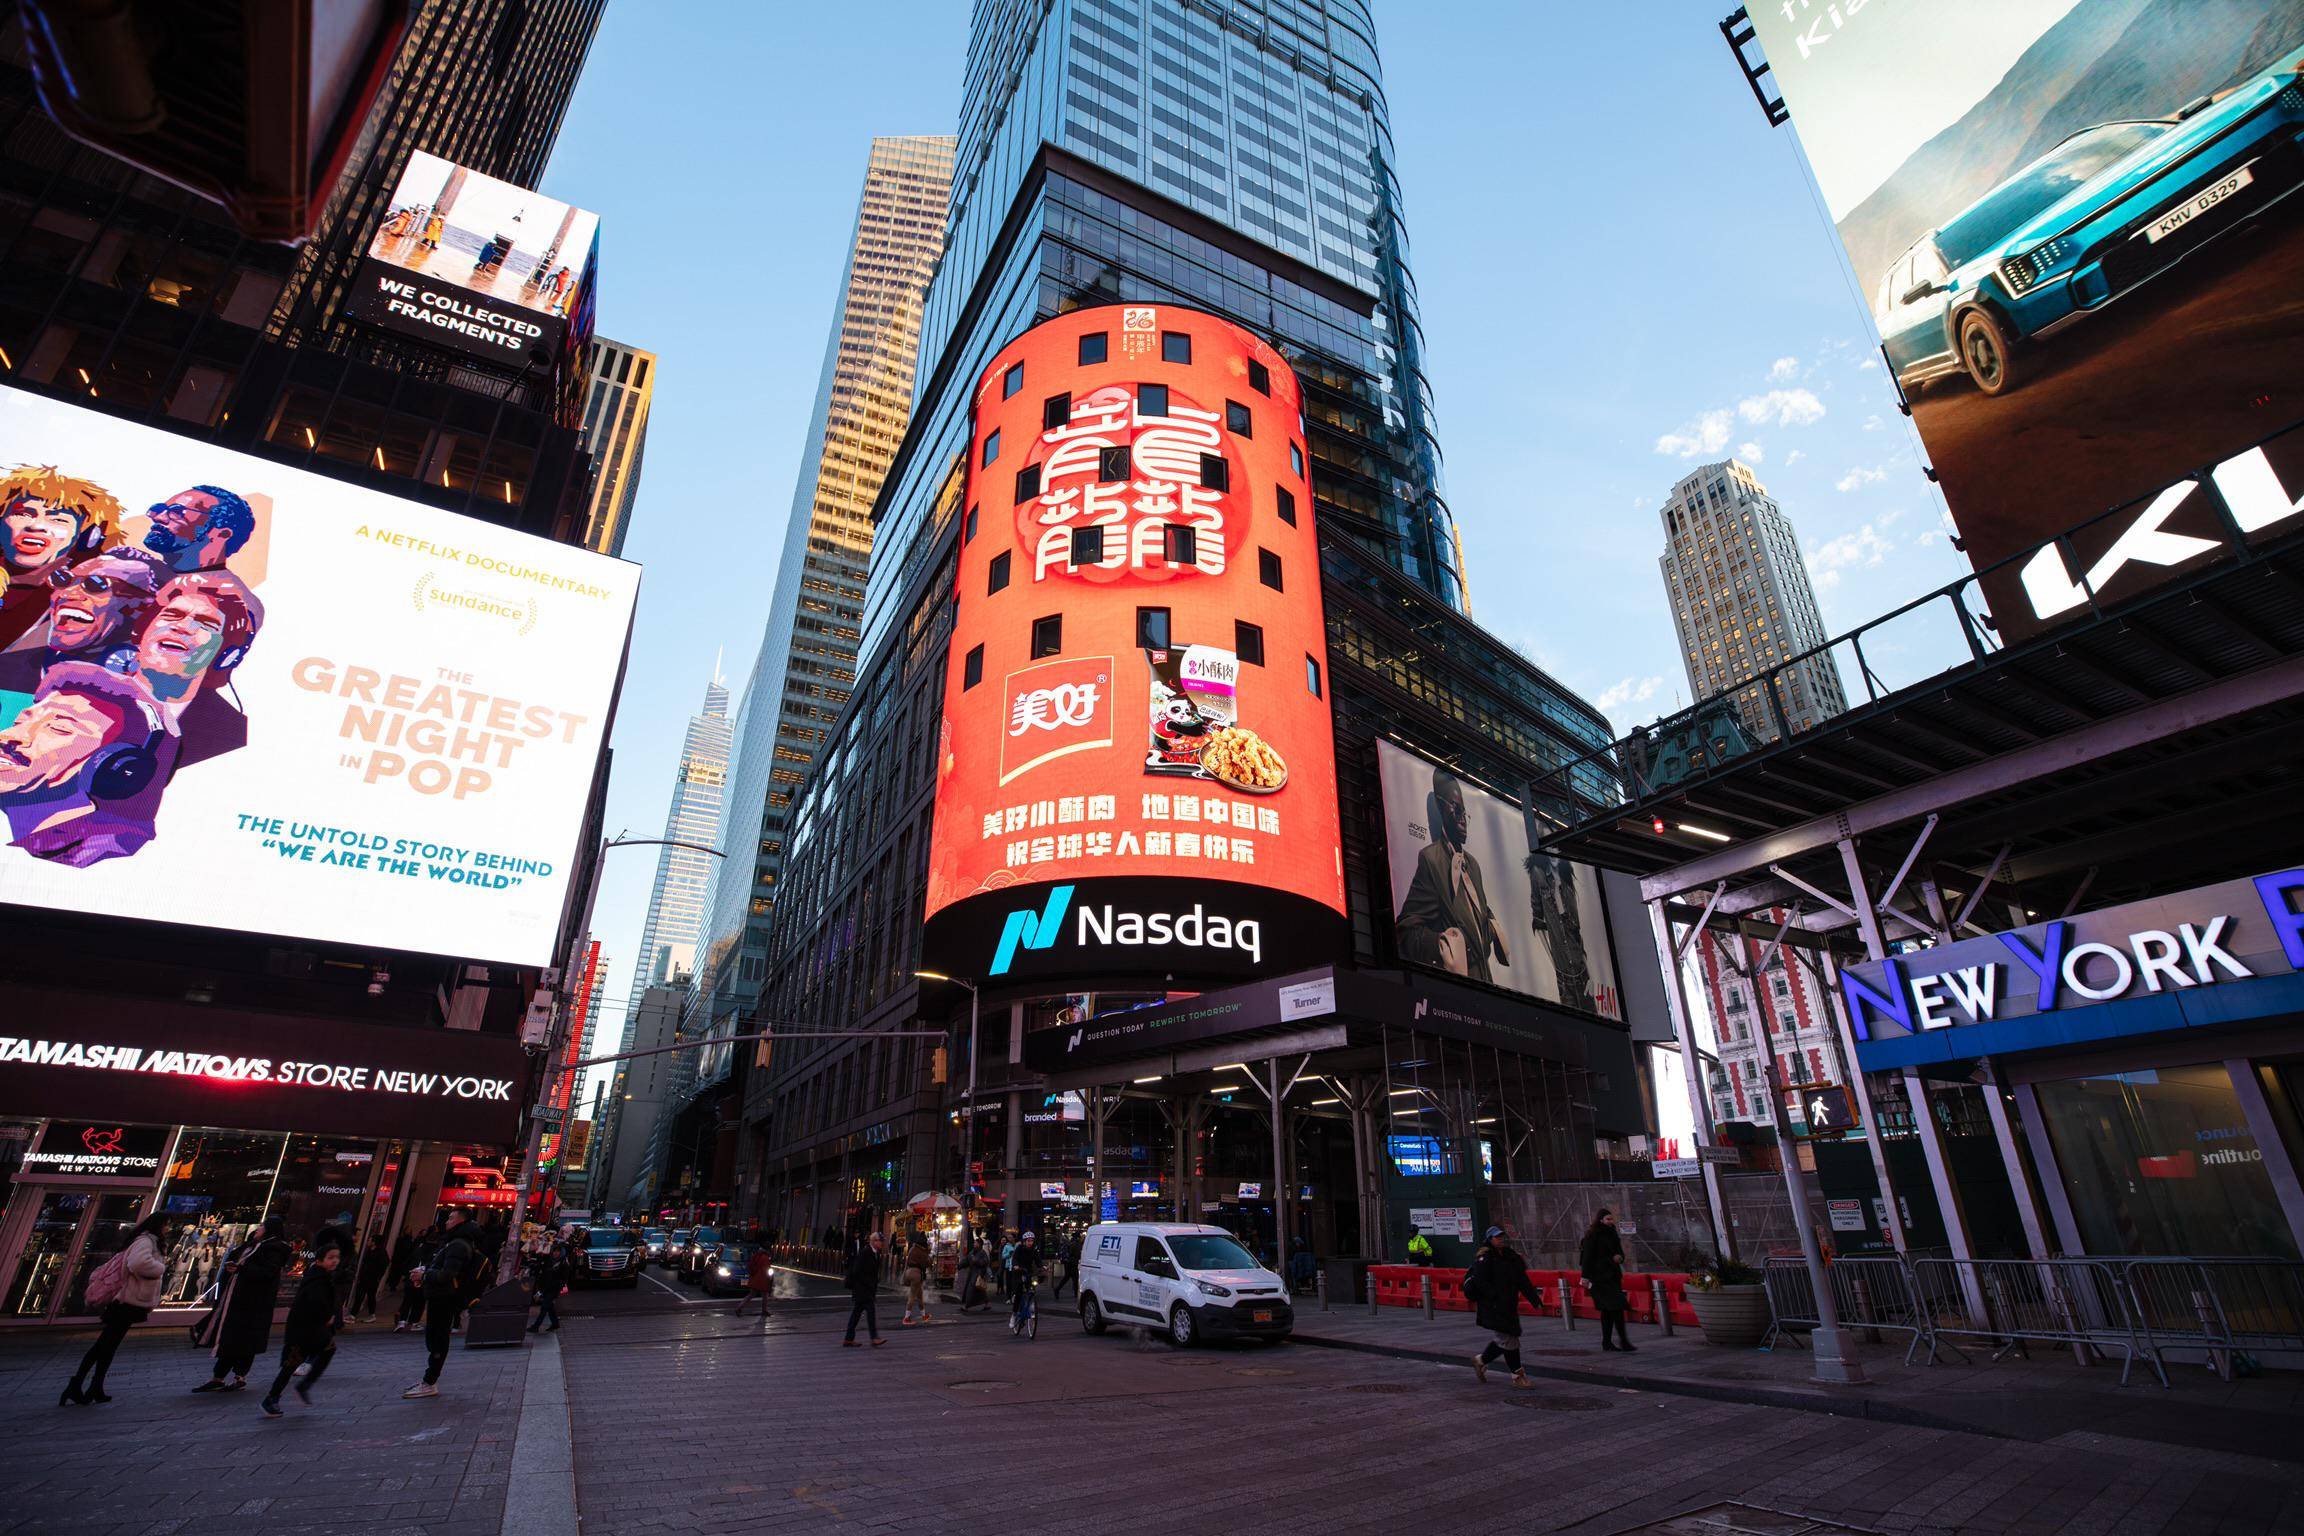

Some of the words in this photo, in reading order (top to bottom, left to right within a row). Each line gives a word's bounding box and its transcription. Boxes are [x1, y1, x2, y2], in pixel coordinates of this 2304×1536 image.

[2159, 207, 2192, 234] KMV
[2198, 179, 2238, 210] 0329
[379, 277, 416, 299] WE
[420, 291, 543, 338] COLLECTED
[386, 299, 522, 350] FRAGMENTS
[355, 525, 371, 539] A
[375, 528, 462, 562] NETFLIX
[466, 552, 612, 601] DOCUMENTARY
[429, 586, 523, 621] sundance
[436, 666, 474, 686] THE
[1198, 658, 1234, 682] 小酥肉
[290, 656, 588, 744] GREATEST
[338, 704, 526, 769] NIGHT
[339, 752, 362, 770] IN
[362, 749, 493, 801] POP
[982, 793, 1117, 841] 美好小酥肉
[1141, 793, 1281, 837] 地道中国味
[237, 813, 284, 836] THE
[289, 821, 387, 852] UNTOLD
[393, 839, 470, 865] STORY
[473, 850, 554, 878] BEHIND
[319, 849, 371, 871] ARE
[377, 856, 422, 877] THE
[1005, 831, 1256, 868] 祝全球华人新春快乐
[1077, 903, 1262, 964] Nasdaq
[1840, 957, 2001, 1042] NEW
[1999, 915, 2258, 1012] YORK
[1293, 996, 1321, 1009] Turner
[1432, 1008, 1463, 1022] QUESTION
[1463, 1015, 1483, 1026] TODAY
[1087, 1028, 1120, 1041] QUESTION
[1122, 1022, 1145, 1034] TODAY
[1150, 1014, 1186, 1028] REWRITE
[1189, 1003, 1240, 1020] TOMORROW
[0, 1037, 139, 1070] TAMASHII
[139, 1049, 272, 1081] NATIONS
[276, 1060, 368, 1091] STORE
[374, 1068, 439, 1095] NEW
[441, 1074, 514, 1102] YORK
[1024, 1112, 1057, 1123] branded
[23, 1152, 74, 1164] TAMASHII
[73, 1154, 121, 1166] NATIONS
[122, 1156, 159, 1168] STORE
[59, 1164, 85, 1173] NEW
[88, 1165, 118, 1174] YORK
[318, 1184, 360, 1196] Welcome
[1101, 1235, 1121, 1250] ETI
